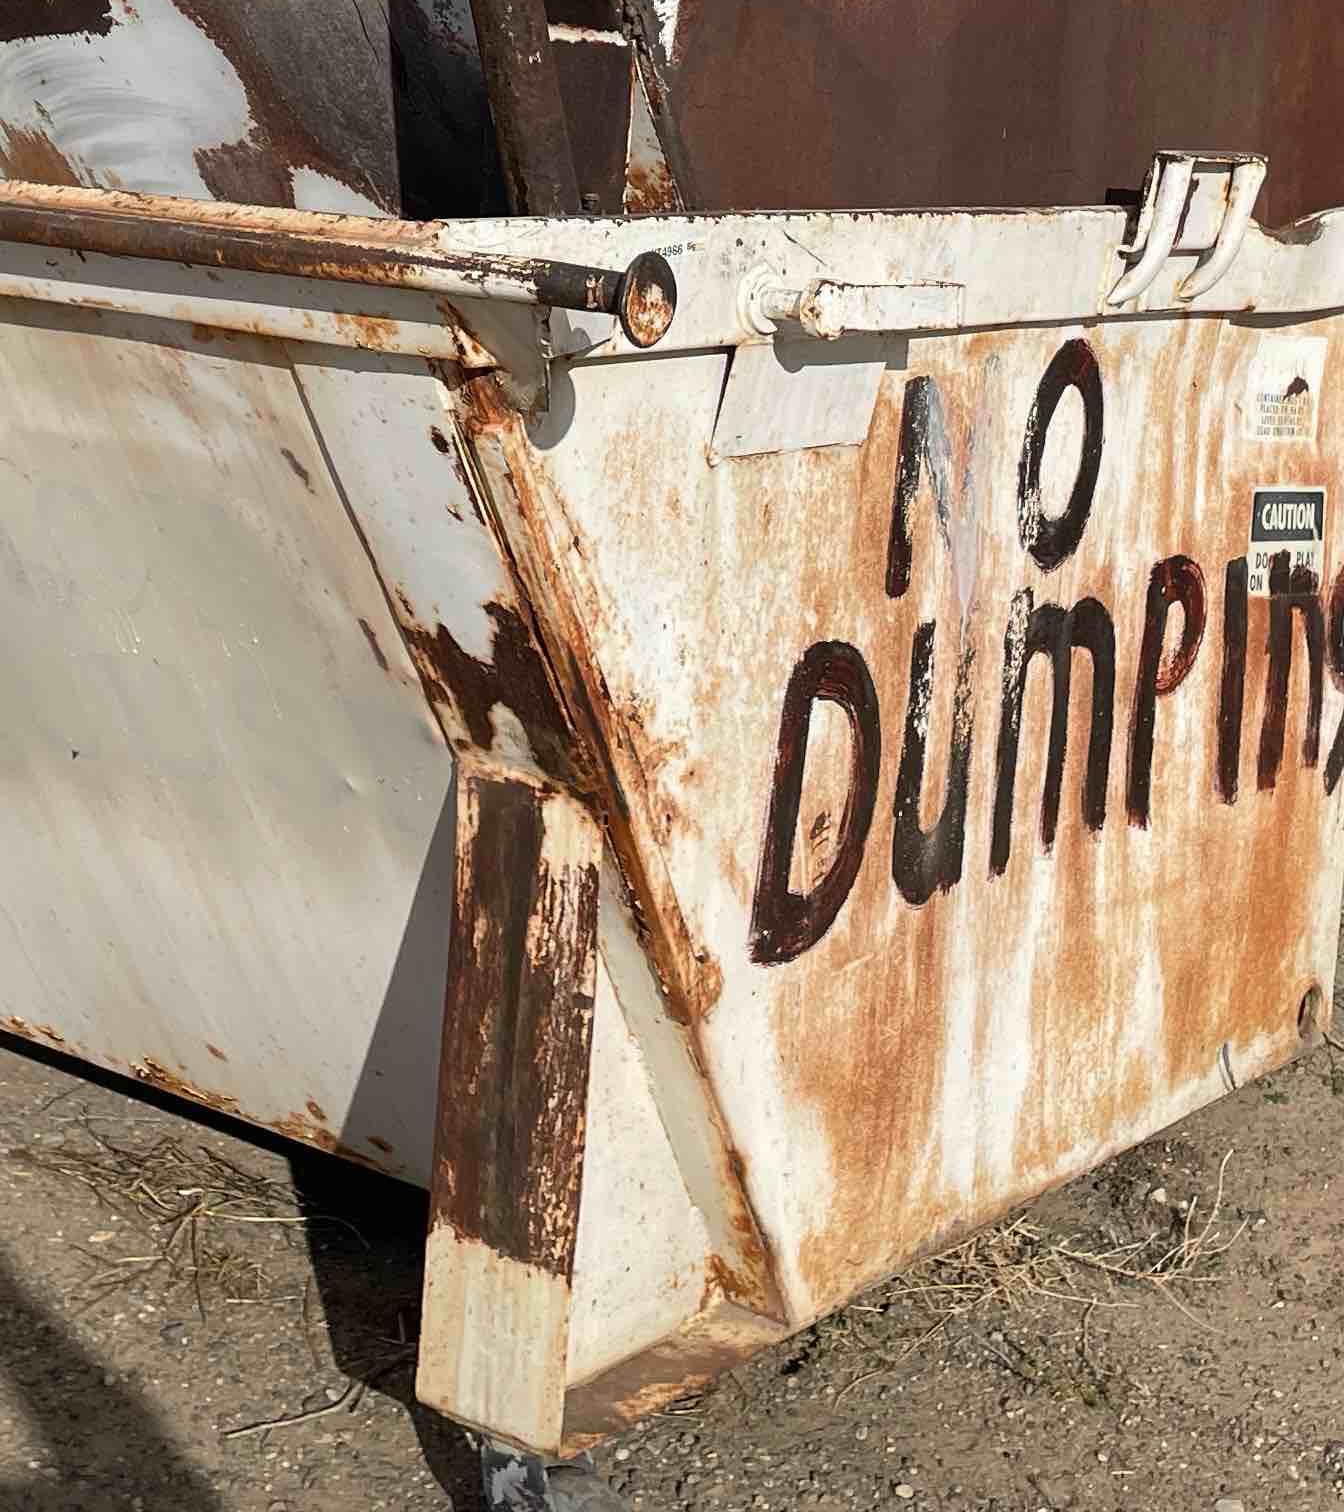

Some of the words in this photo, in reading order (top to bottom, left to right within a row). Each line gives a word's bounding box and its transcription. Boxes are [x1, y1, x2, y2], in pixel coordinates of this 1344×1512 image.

[1261, 503, 1316, 531] CAUTION
[1256, 552, 1268, 569] DO
[1249, 574, 1264, 592] ON
